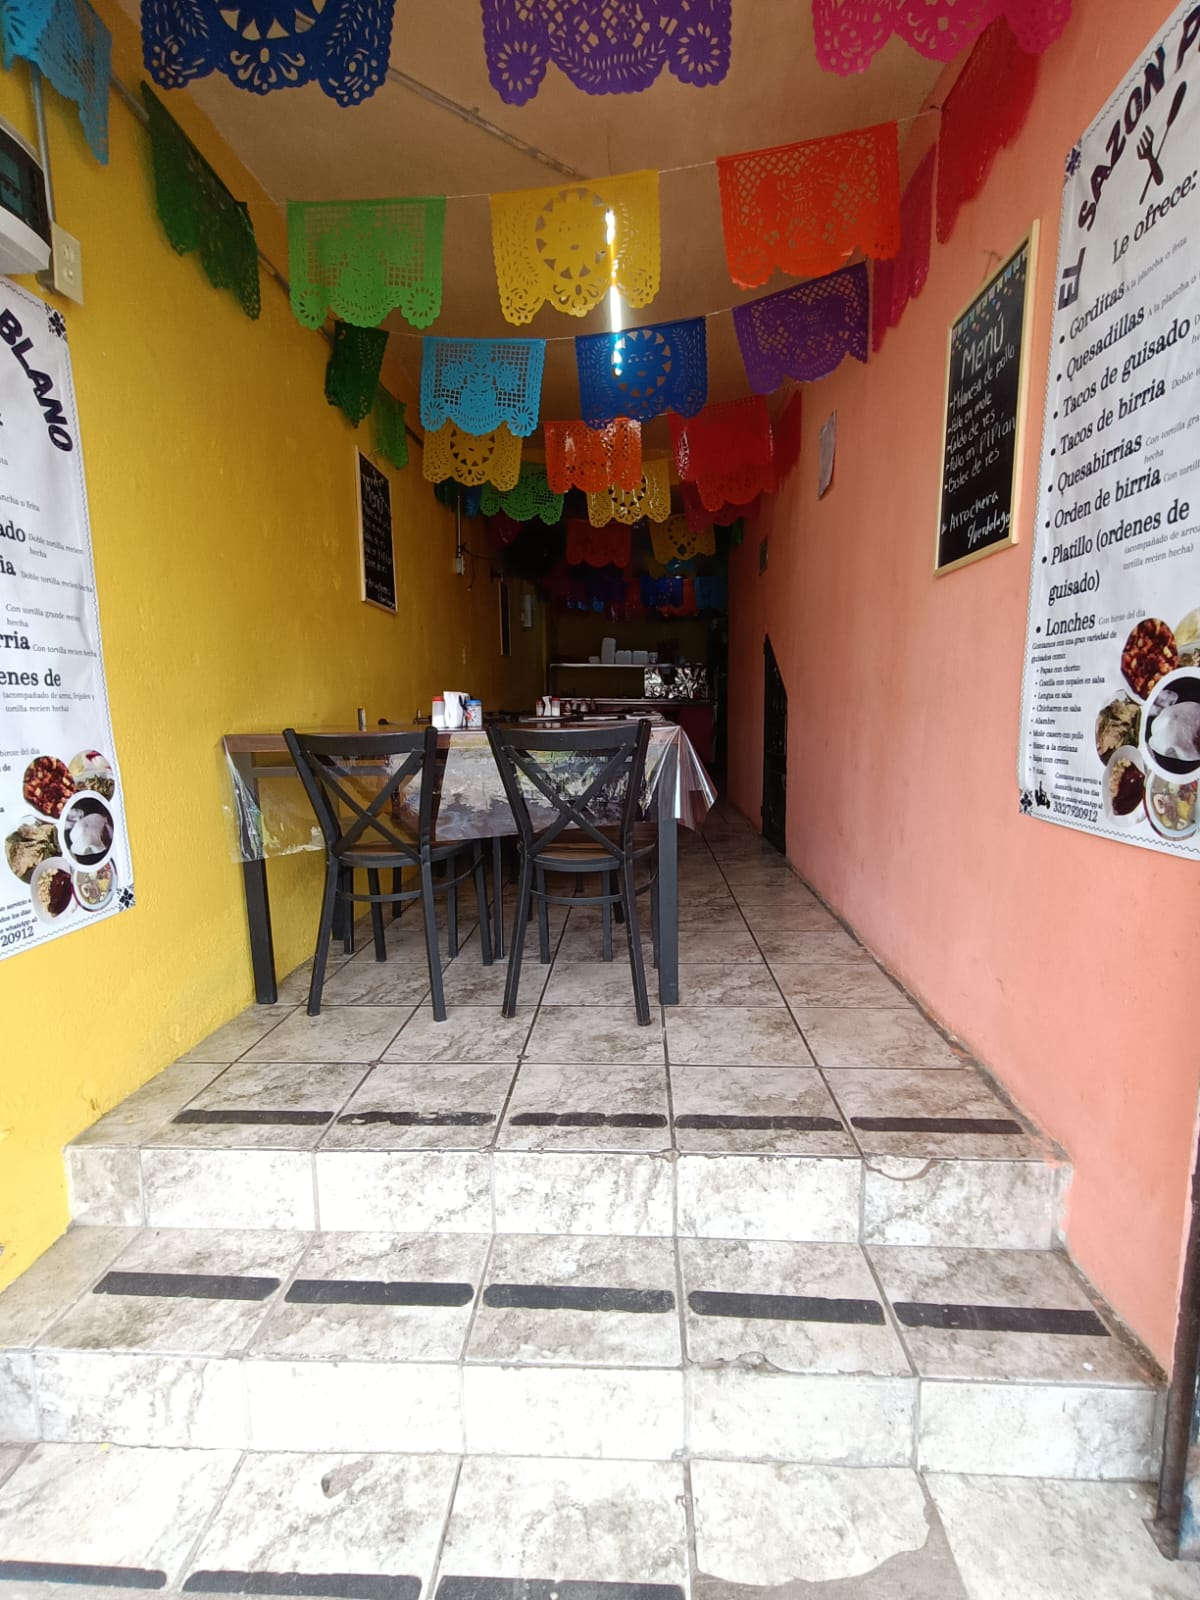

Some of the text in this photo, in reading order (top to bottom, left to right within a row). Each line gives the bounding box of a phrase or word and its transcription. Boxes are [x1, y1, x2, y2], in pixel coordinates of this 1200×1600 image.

[1057, 246, 1086, 311] EL
[1078, 45, 1165, 232] SAZON
[1112, 169, 1198, 265] Le ofrece:
[1070, 281, 1125, 340] Gorditas
[1063, 318, 1190, 418] Tacos de guisado
[1067, 306, 1145, 382] Quesadillas
[1060, 378, 1166, 456] Tacos de birria
[1054, 468, 1161, 529] Orden de birria
[1057, 434, 1142, 497] Quesabirrias
[1051, 497, 1191, 566] Platillo (ordenes de
[1048, 569, 1100, 607] guisado)
[1046, 612, 1096, 637] Lonches
[44, 668, 61, 687] de
